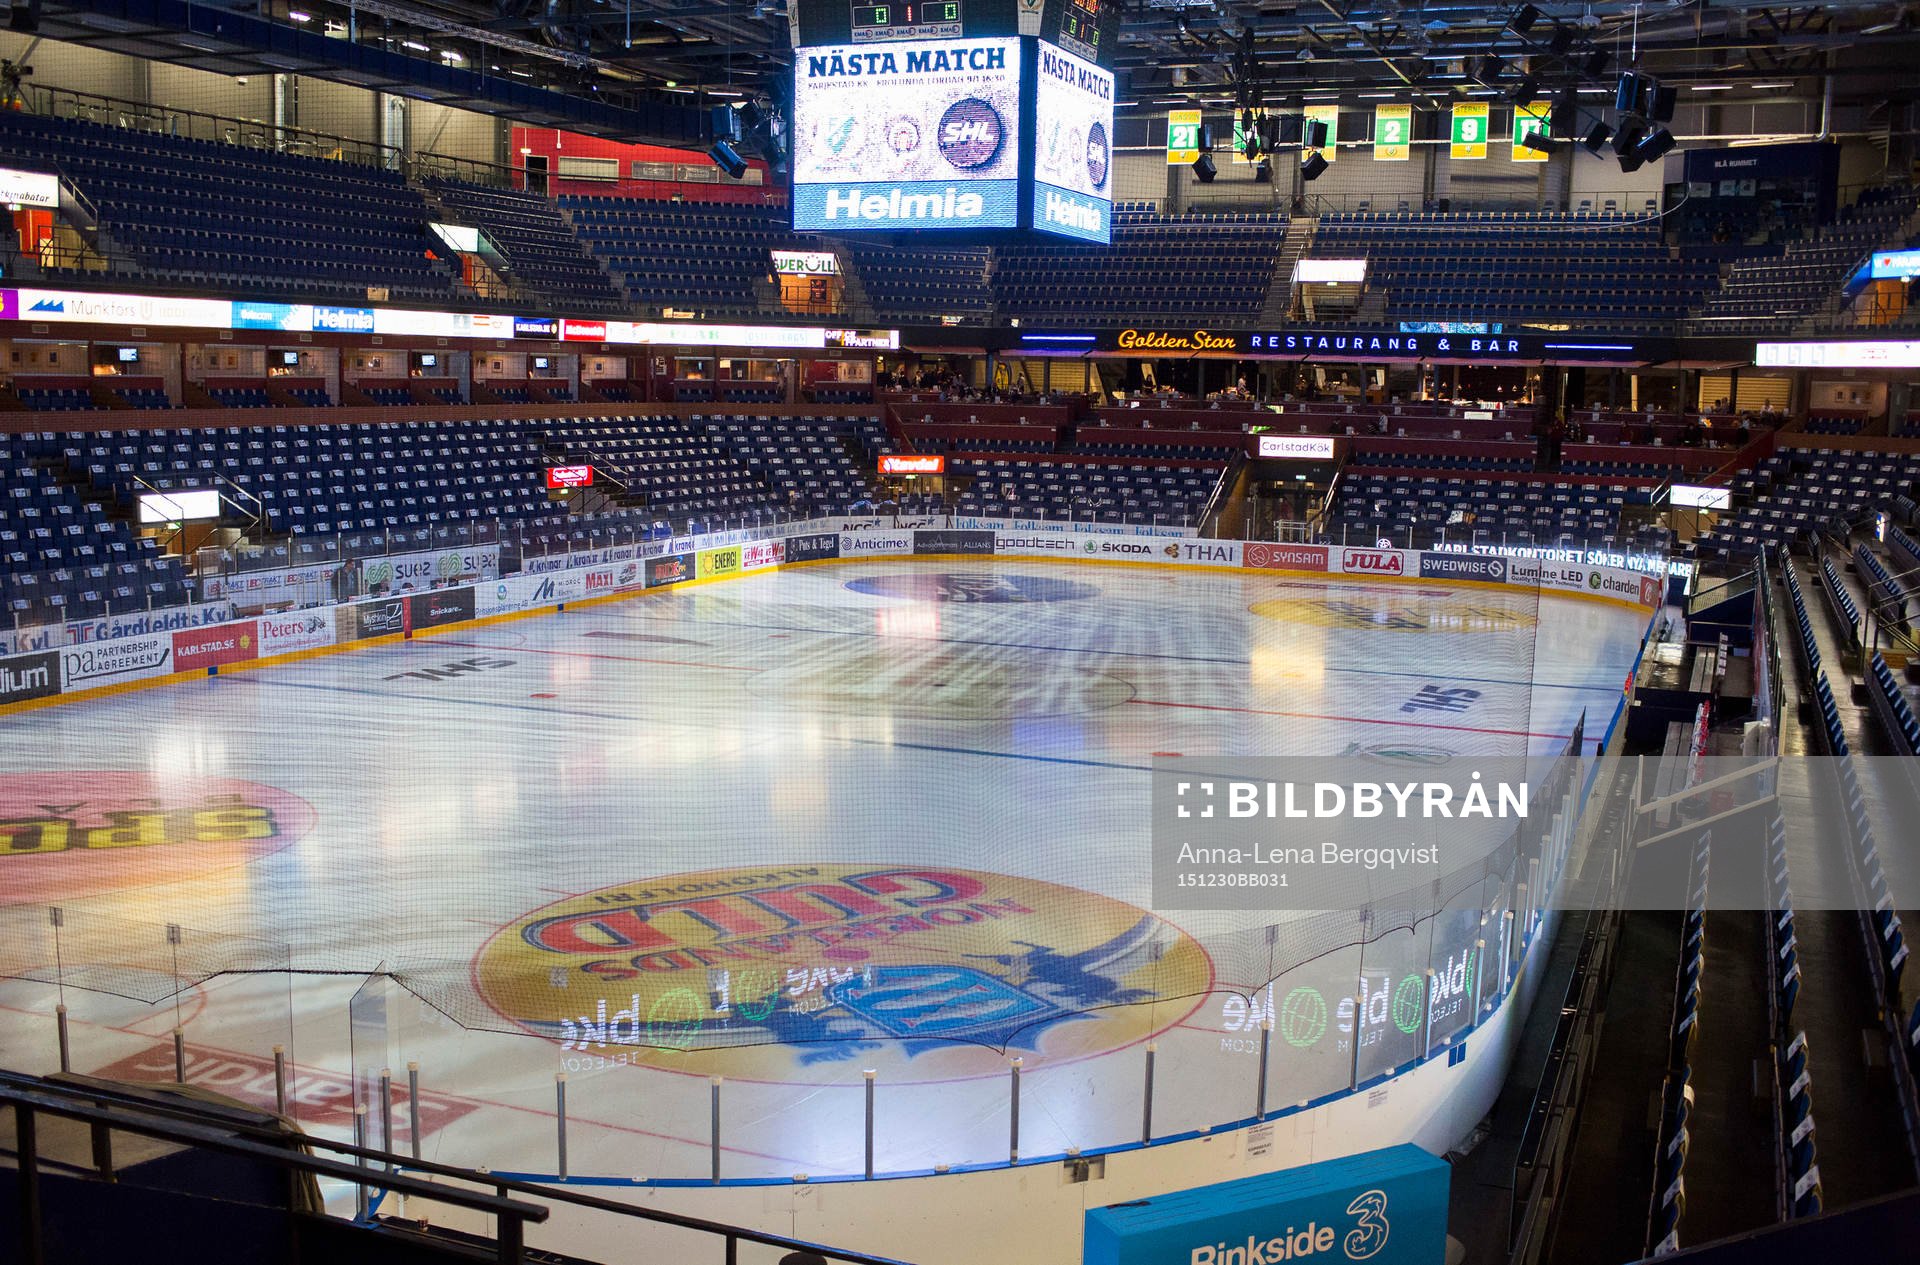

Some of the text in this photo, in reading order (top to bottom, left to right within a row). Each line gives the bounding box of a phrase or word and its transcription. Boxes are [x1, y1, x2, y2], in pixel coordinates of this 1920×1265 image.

[875, 7, 887, 24] 0
[944, 3, 957, 20] 0
[807, 47, 1006, 78] NÄSTA MATCH
[1043, 49, 1110, 101] NÄSTA MATCH
[942, 121, 995, 144] SHL
[1172, 126, 1197, 149] 21
[1383, 120, 1401, 143] 2
[1461, 118, 1478, 142] 9
[825, 187, 984, 221] Helmia
[1045, 190, 1101, 232] Helmia
[71, 300, 136, 318] Munkfors
[313, 307, 374, 330] Helmia
[1117, 328, 1520, 351] Golden Star RESTAURANG & BAR
[1261, 440, 1331, 453] CarlstadKök
[854, 537, 909, 551] Anticimex
[995, 535, 1075, 550] goodtech
[1101, 541, 1152, 555] ŠKODA
[1183, 543, 1233, 562] THAI
[714, 551, 737, 570] ENERGI
[1272, 550, 1325, 566] SYNSAM
[1345, 553, 1401, 572] JULA
[1422, 558, 1487, 575] SWEDWISE
[1587, 548, 1624, 568] SÖKER
[585, 571, 614, 590] MAXI
[1511, 564, 1584, 583] Lumine LED
[1602, 576, 1640, 597] charden
[263, 620, 304, 640] Peters
[97, 640, 159, 657] PARTNERSHIP
[177, 638, 235, 657] KARLSTAD.SE
[63, 650, 97, 688] pa
[97, 652, 160, 671] AGREEMENT
[595, 867, 819, 904] ALKOHOLFRI
[521, 870, 989, 956] GULD
[580, 897, 1036, 982] NORRLANDS
[1344, 1188, 1390, 1262] 3
[1190, 1221, 1336, 1265] Rinkside
